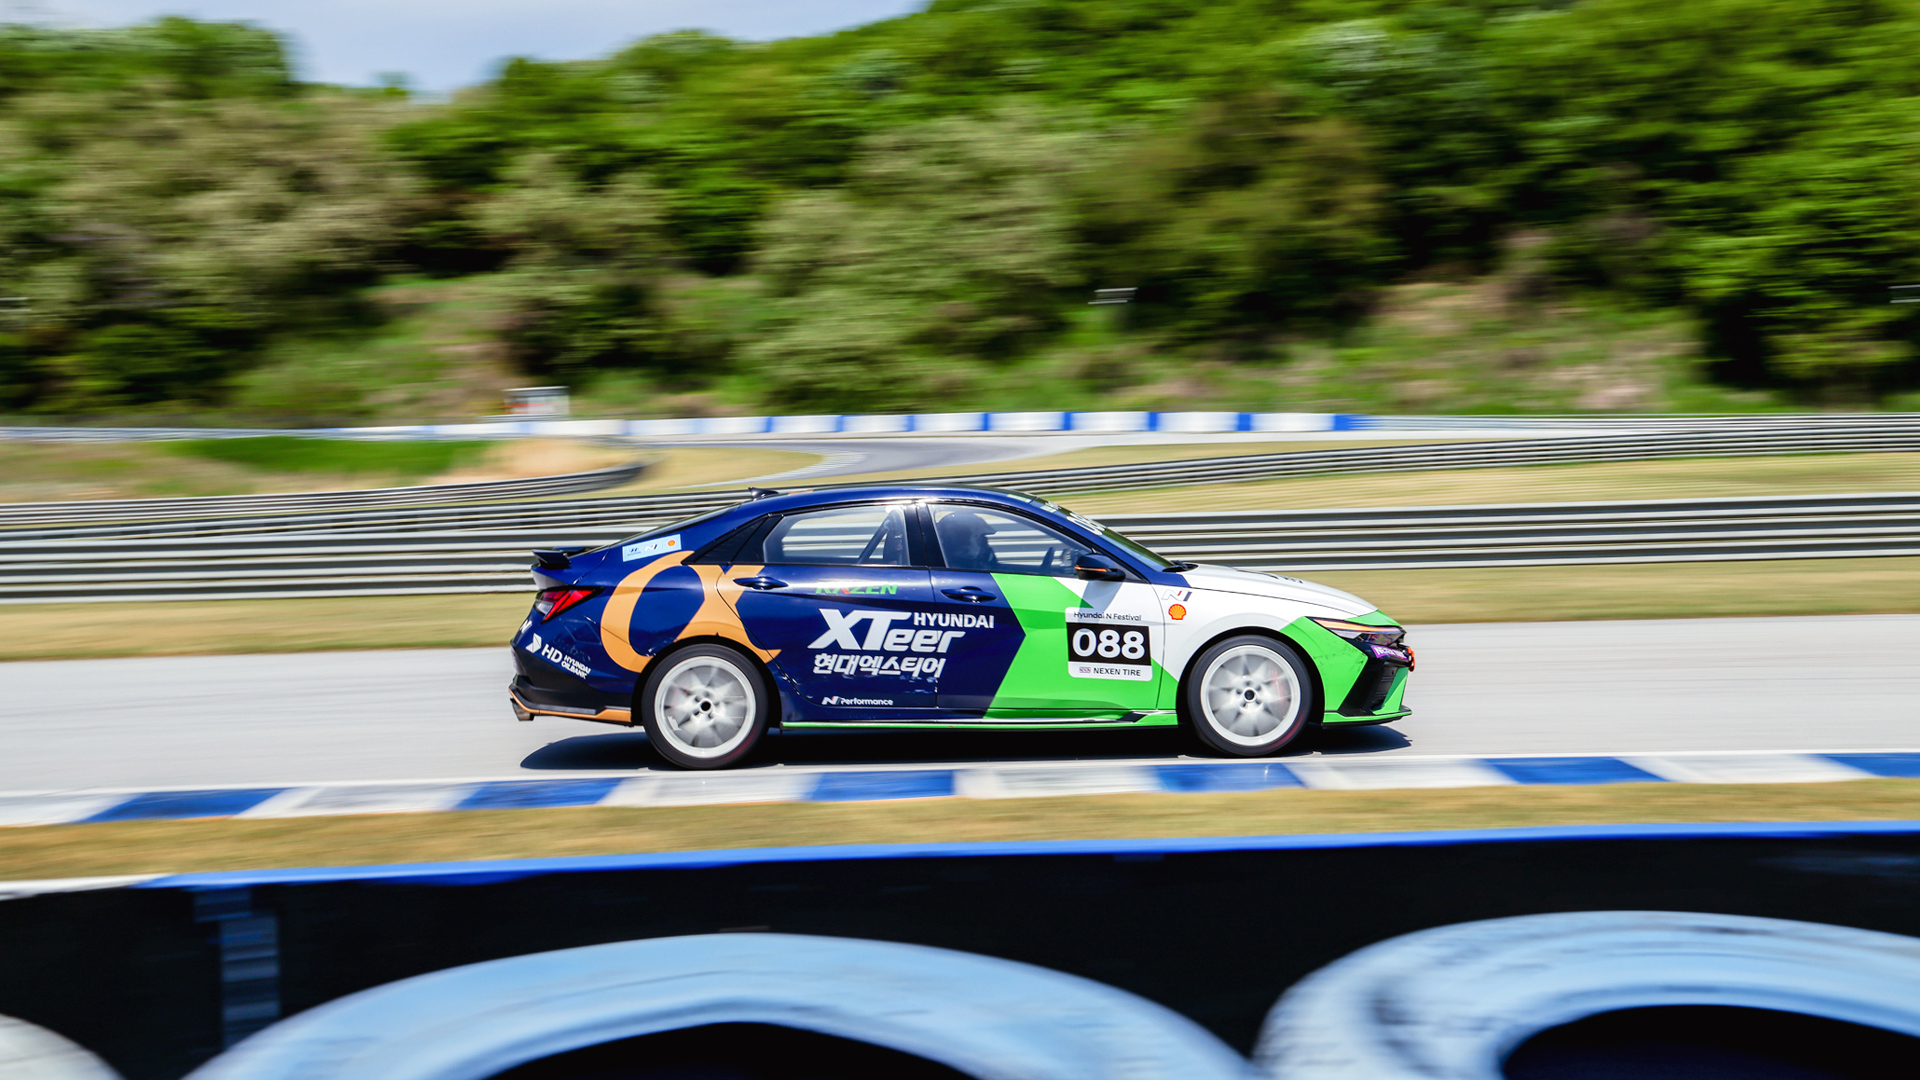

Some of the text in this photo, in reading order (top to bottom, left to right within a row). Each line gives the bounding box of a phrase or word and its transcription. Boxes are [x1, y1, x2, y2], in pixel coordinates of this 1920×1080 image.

[913, 612, 995, 629] HYUNDAI
[1073, 611, 1105, 620] Hyundai
[1113, 613, 1142, 622] Festival
[807, 608, 966, 653] XTeer
[541, 643, 563, 663] HD
[1072, 628, 1145, 660] 088
[561, 660, 589, 680] OILBANK
[564, 655, 591, 674] HYUNDAI
[813, 653, 946, 678] 현대엑스티어
[1093, 667, 1141, 677] NEXEN TIRE
[840, 697, 894, 706] Performance
